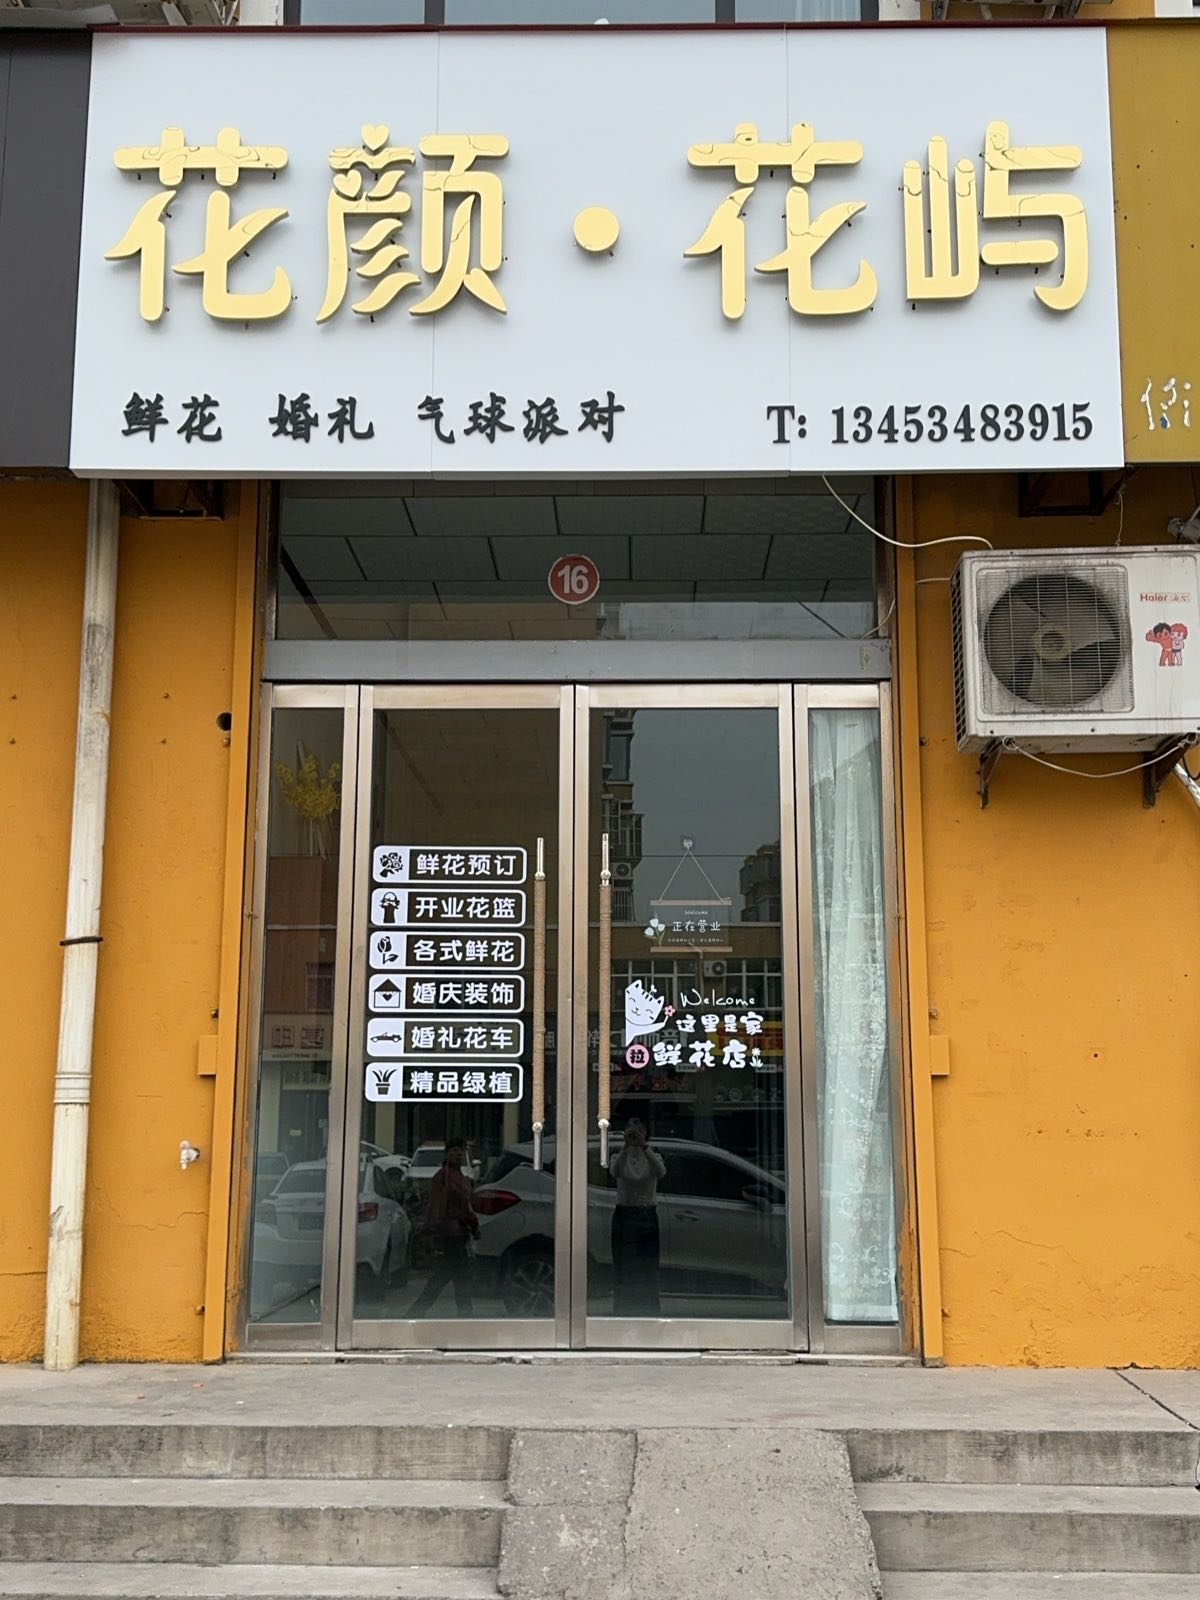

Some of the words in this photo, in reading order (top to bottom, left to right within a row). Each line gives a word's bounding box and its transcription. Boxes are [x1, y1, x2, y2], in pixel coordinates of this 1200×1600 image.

[121, 391, 223, 443] 鲜花
[269, 393, 374, 443] 婚礼
[417, 391, 625, 443] 气球派对
[830, 401, 1093, 444] 13453483915
[557, 564, 589, 594] 16
[1140, 593, 1168, 602] Haier
[416, 853, 517, 876] 鲜花预订
[415, 896, 516, 919] 开业花篮
[672, 919, 721, 933] 正在营业
[413, 939, 515, 963] 各式鲜花
[412, 982, 515, 1006] 婚庆装饰
[680, 988, 756, 1008] Welcome
[675, 1011, 764, 1035] 这里是家
[411, 1026, 514, 1050] 婚礼花车
[409, 1071, 513, 1095] 精品绿植
